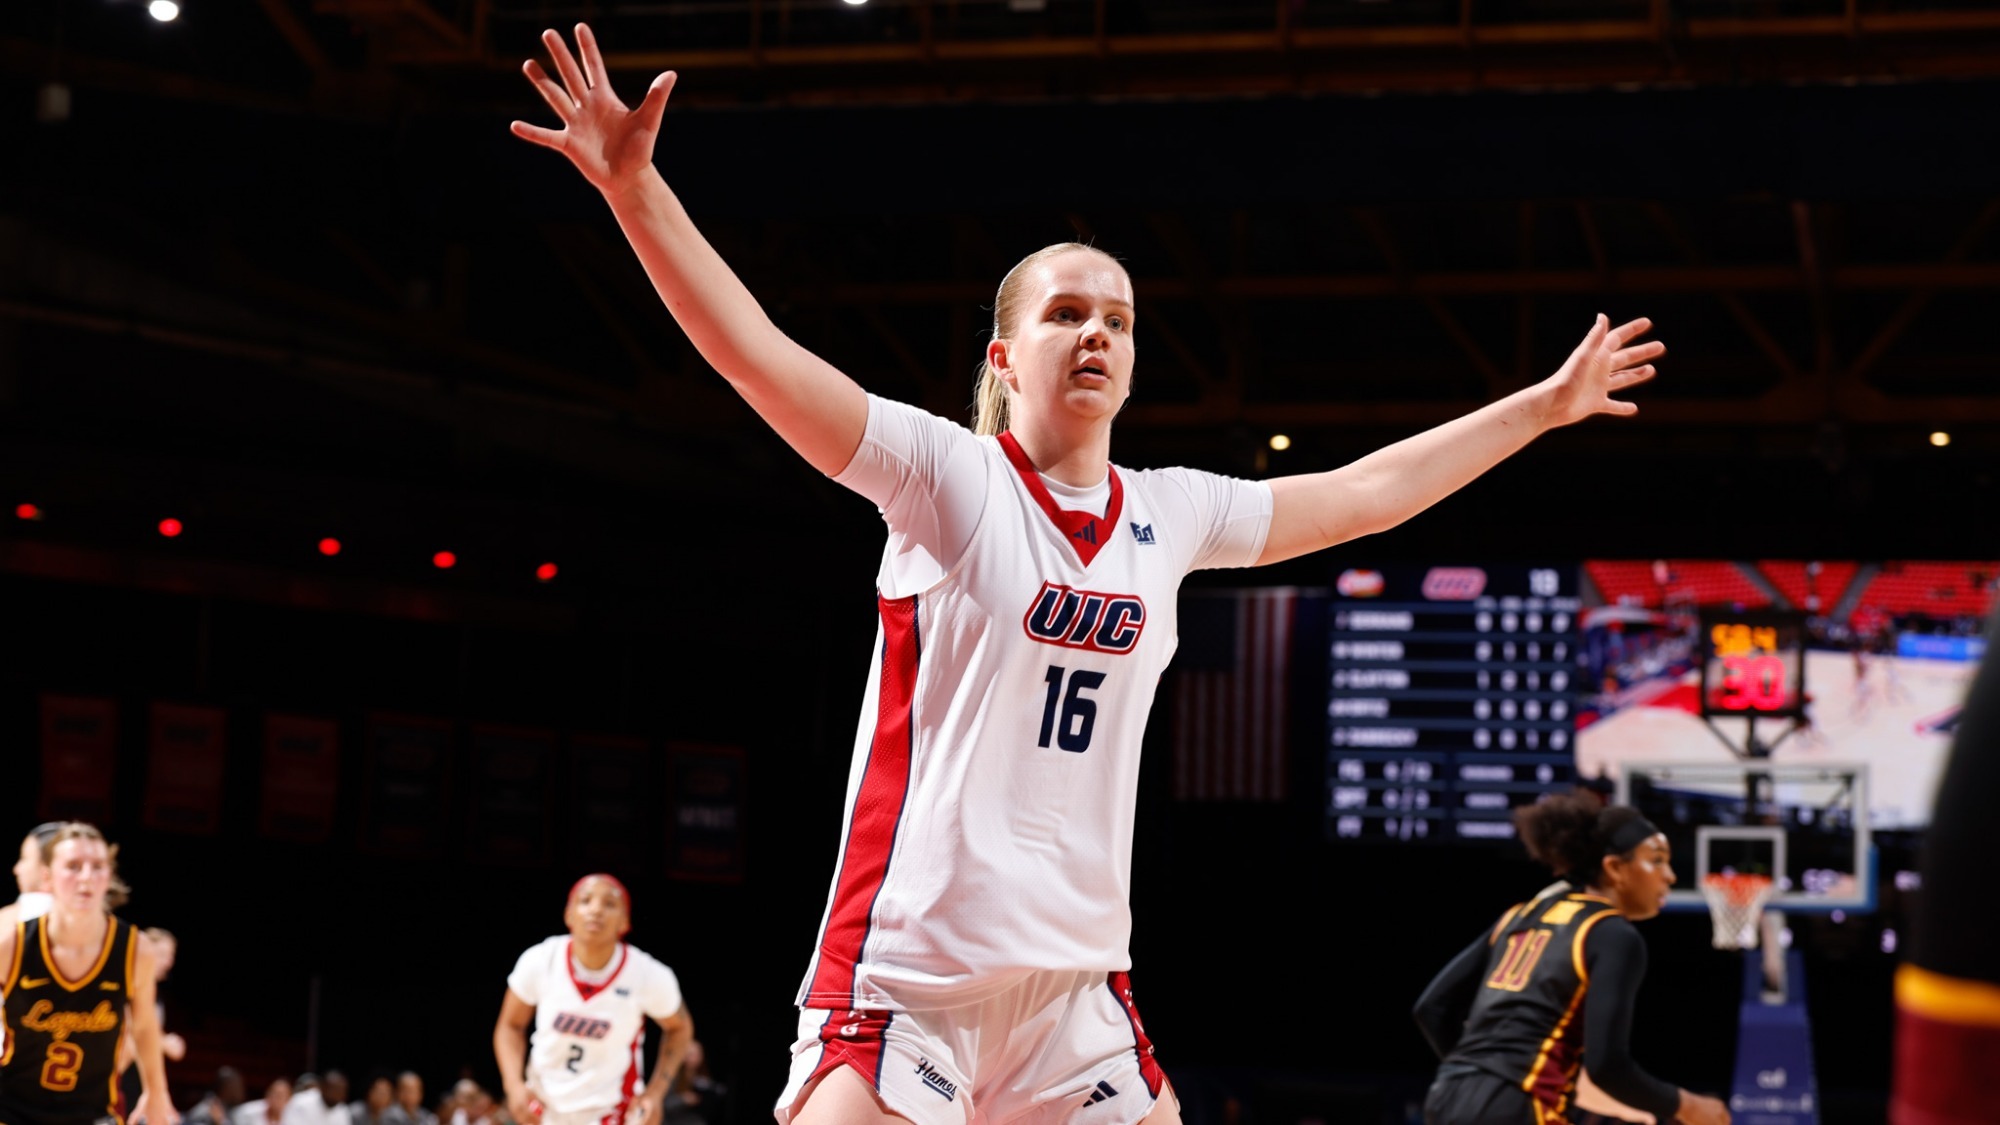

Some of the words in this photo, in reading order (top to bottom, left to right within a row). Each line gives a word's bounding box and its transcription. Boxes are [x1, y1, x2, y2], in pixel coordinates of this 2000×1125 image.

[1028, 587, 1144, 650] UIC
[1038, 664, 1107, 753] 16
[1722, 655, 1785, 711] 30
[1486, 928, 1553, 992] 11
[20, 999, 118, 1040] Loyola
[40, 1041, 84, 1091] 2
[566, 1043, 584, 1074] 2
[914, 1057, 957, 1096] Flames
